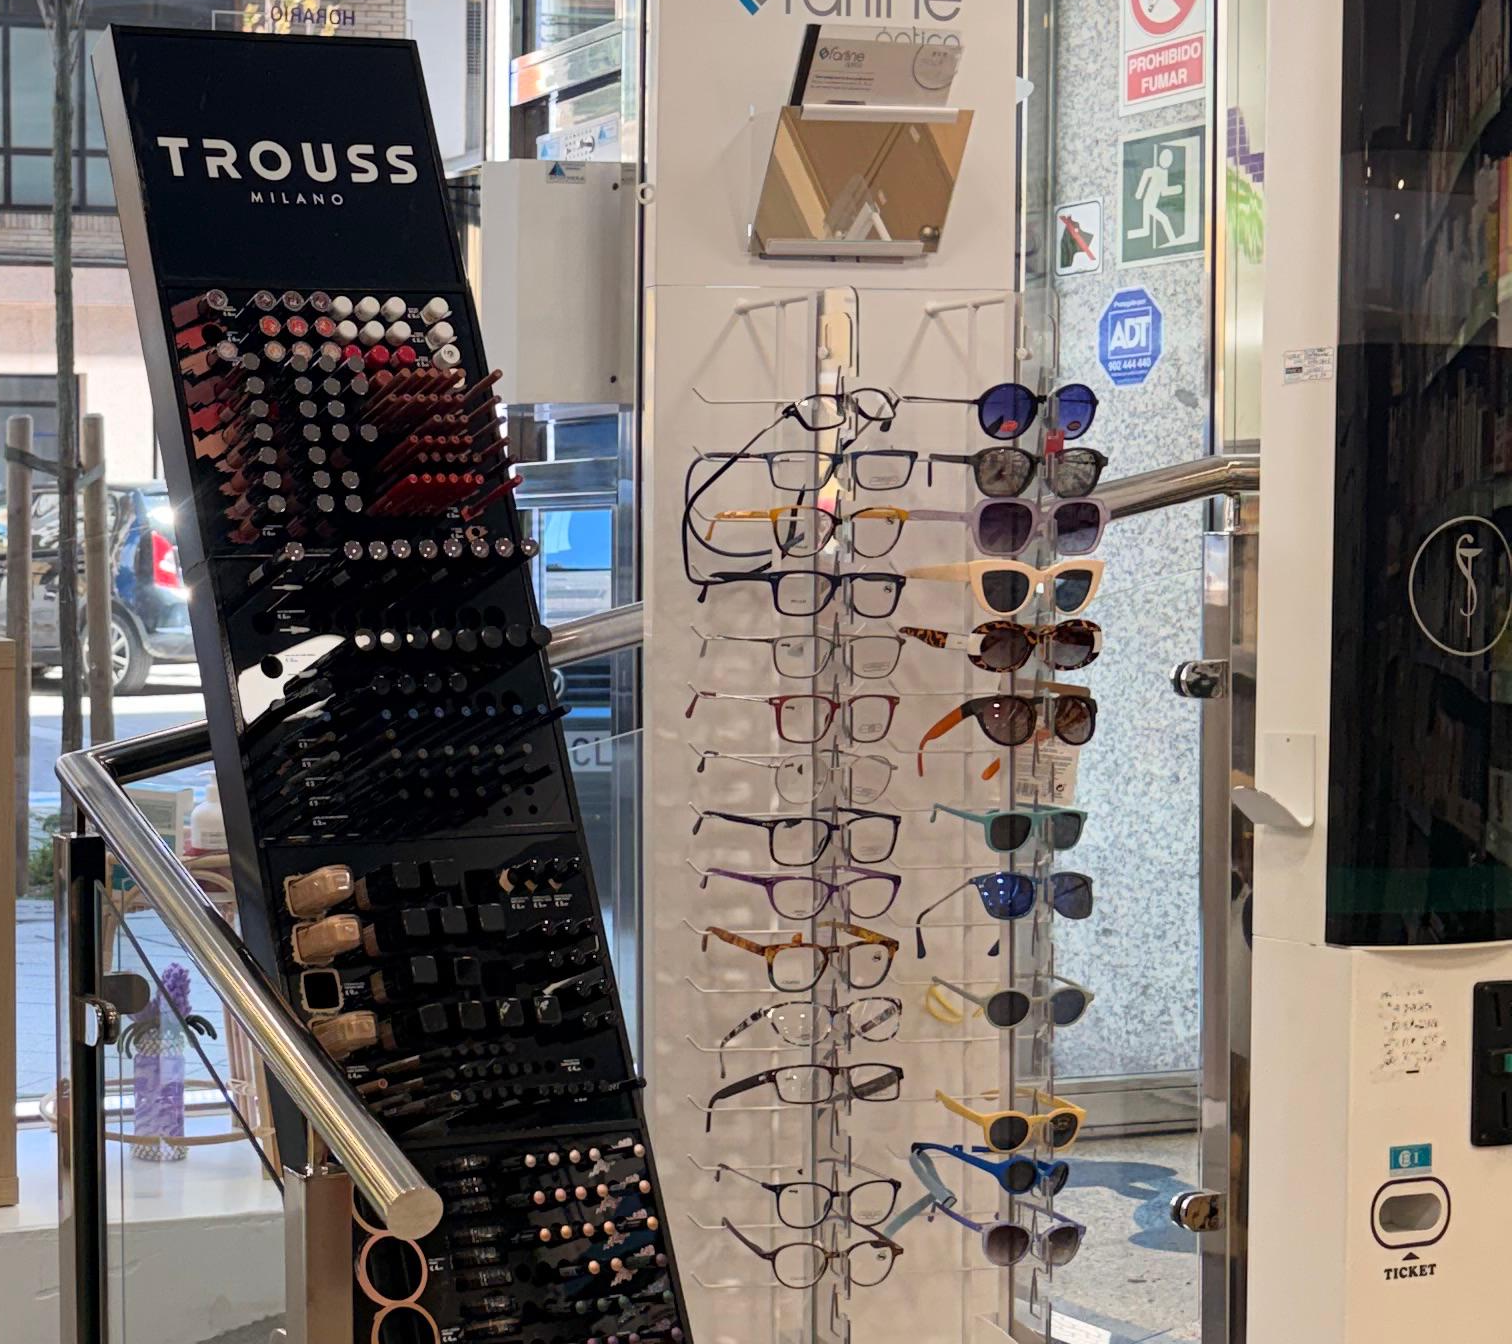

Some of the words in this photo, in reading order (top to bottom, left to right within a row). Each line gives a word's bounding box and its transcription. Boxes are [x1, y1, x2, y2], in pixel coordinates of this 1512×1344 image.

[1127, 39, 1202, 75] PROHIBIDO
[1140, 69, 1189, 93] FUMAR
[156, 136, 419, 184] TROUSS
[250, 191, 344, 206] MILANO
[1110, 315, 1152, 352] ADT
[1384, 1263, 1437, 1281] TICKET
